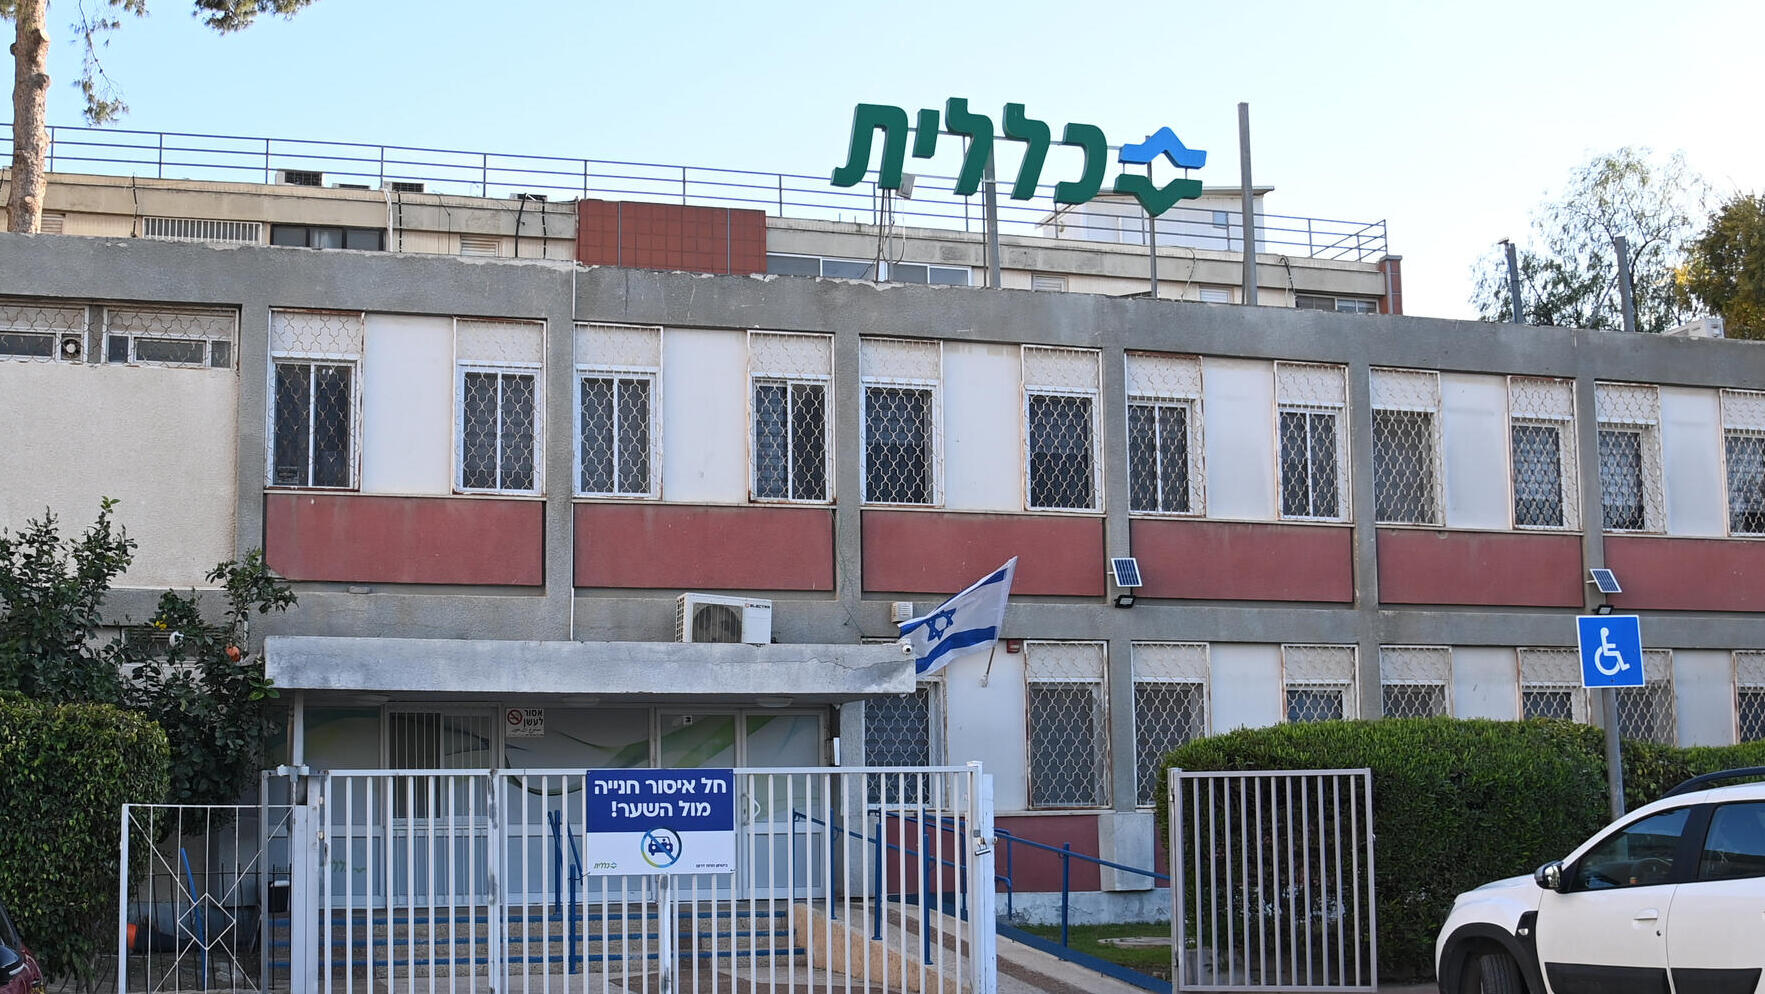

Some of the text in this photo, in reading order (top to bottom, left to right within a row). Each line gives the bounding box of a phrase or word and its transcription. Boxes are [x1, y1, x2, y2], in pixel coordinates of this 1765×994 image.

[830, 97, 1108, 204] כללית
[523, 709, 543, 717] אסור
[523, 716, 544, 728] לעשן
[594, 777, 727, 795] חל איסור חנייה
[611, 800, 711, 818] מול השער!
